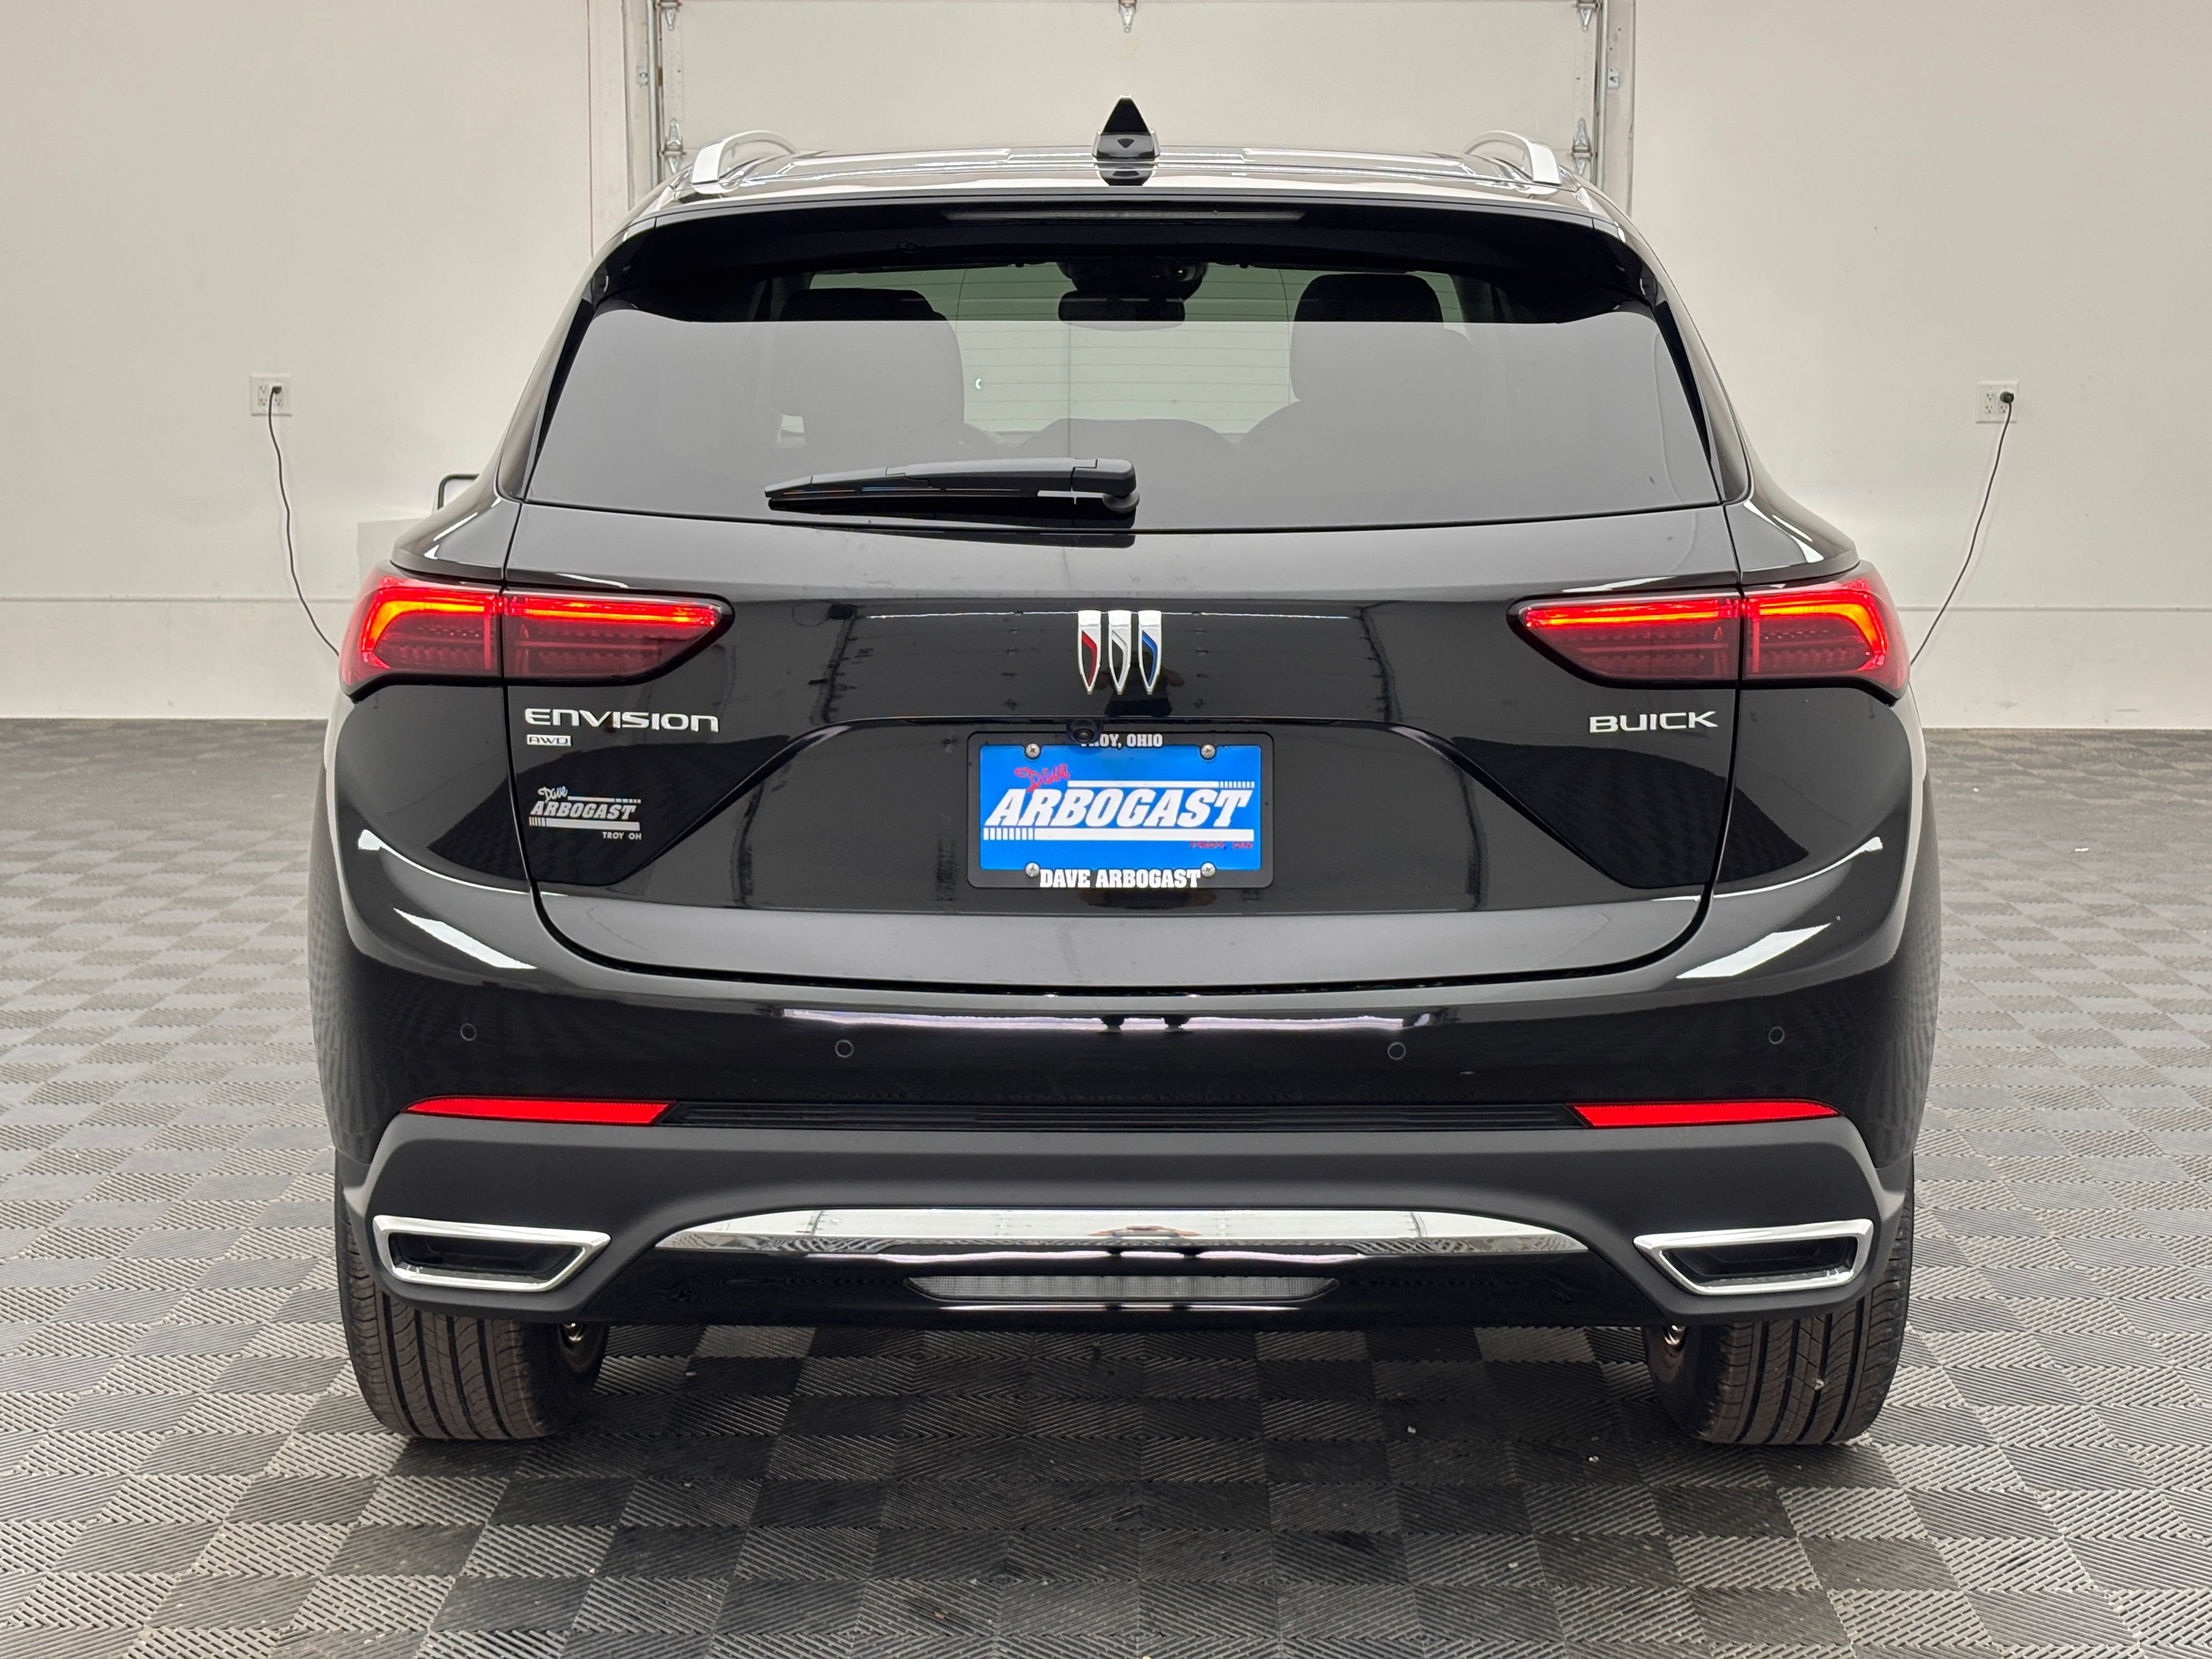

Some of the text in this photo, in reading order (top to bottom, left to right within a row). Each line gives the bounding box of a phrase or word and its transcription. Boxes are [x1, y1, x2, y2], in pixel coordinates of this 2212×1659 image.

[525, 708, 719, 733] ENVISION
[1589, 711, 1718, 733] BUICK
[528, 735, 569, 745] AWD
[1080, 733, 1163, 749] OY, OHIO
[1014, 763, 1070, 792] Dave
[538, 786, 568, 803] Dave
[530, 800, 636, 820] ARBOGAST
[985, 788, 1253, 827] ARBOGAST
[602, 831, 642, 840] TROY OH
[1040, 868, 1201, 888] DAVE ARBOGAST
